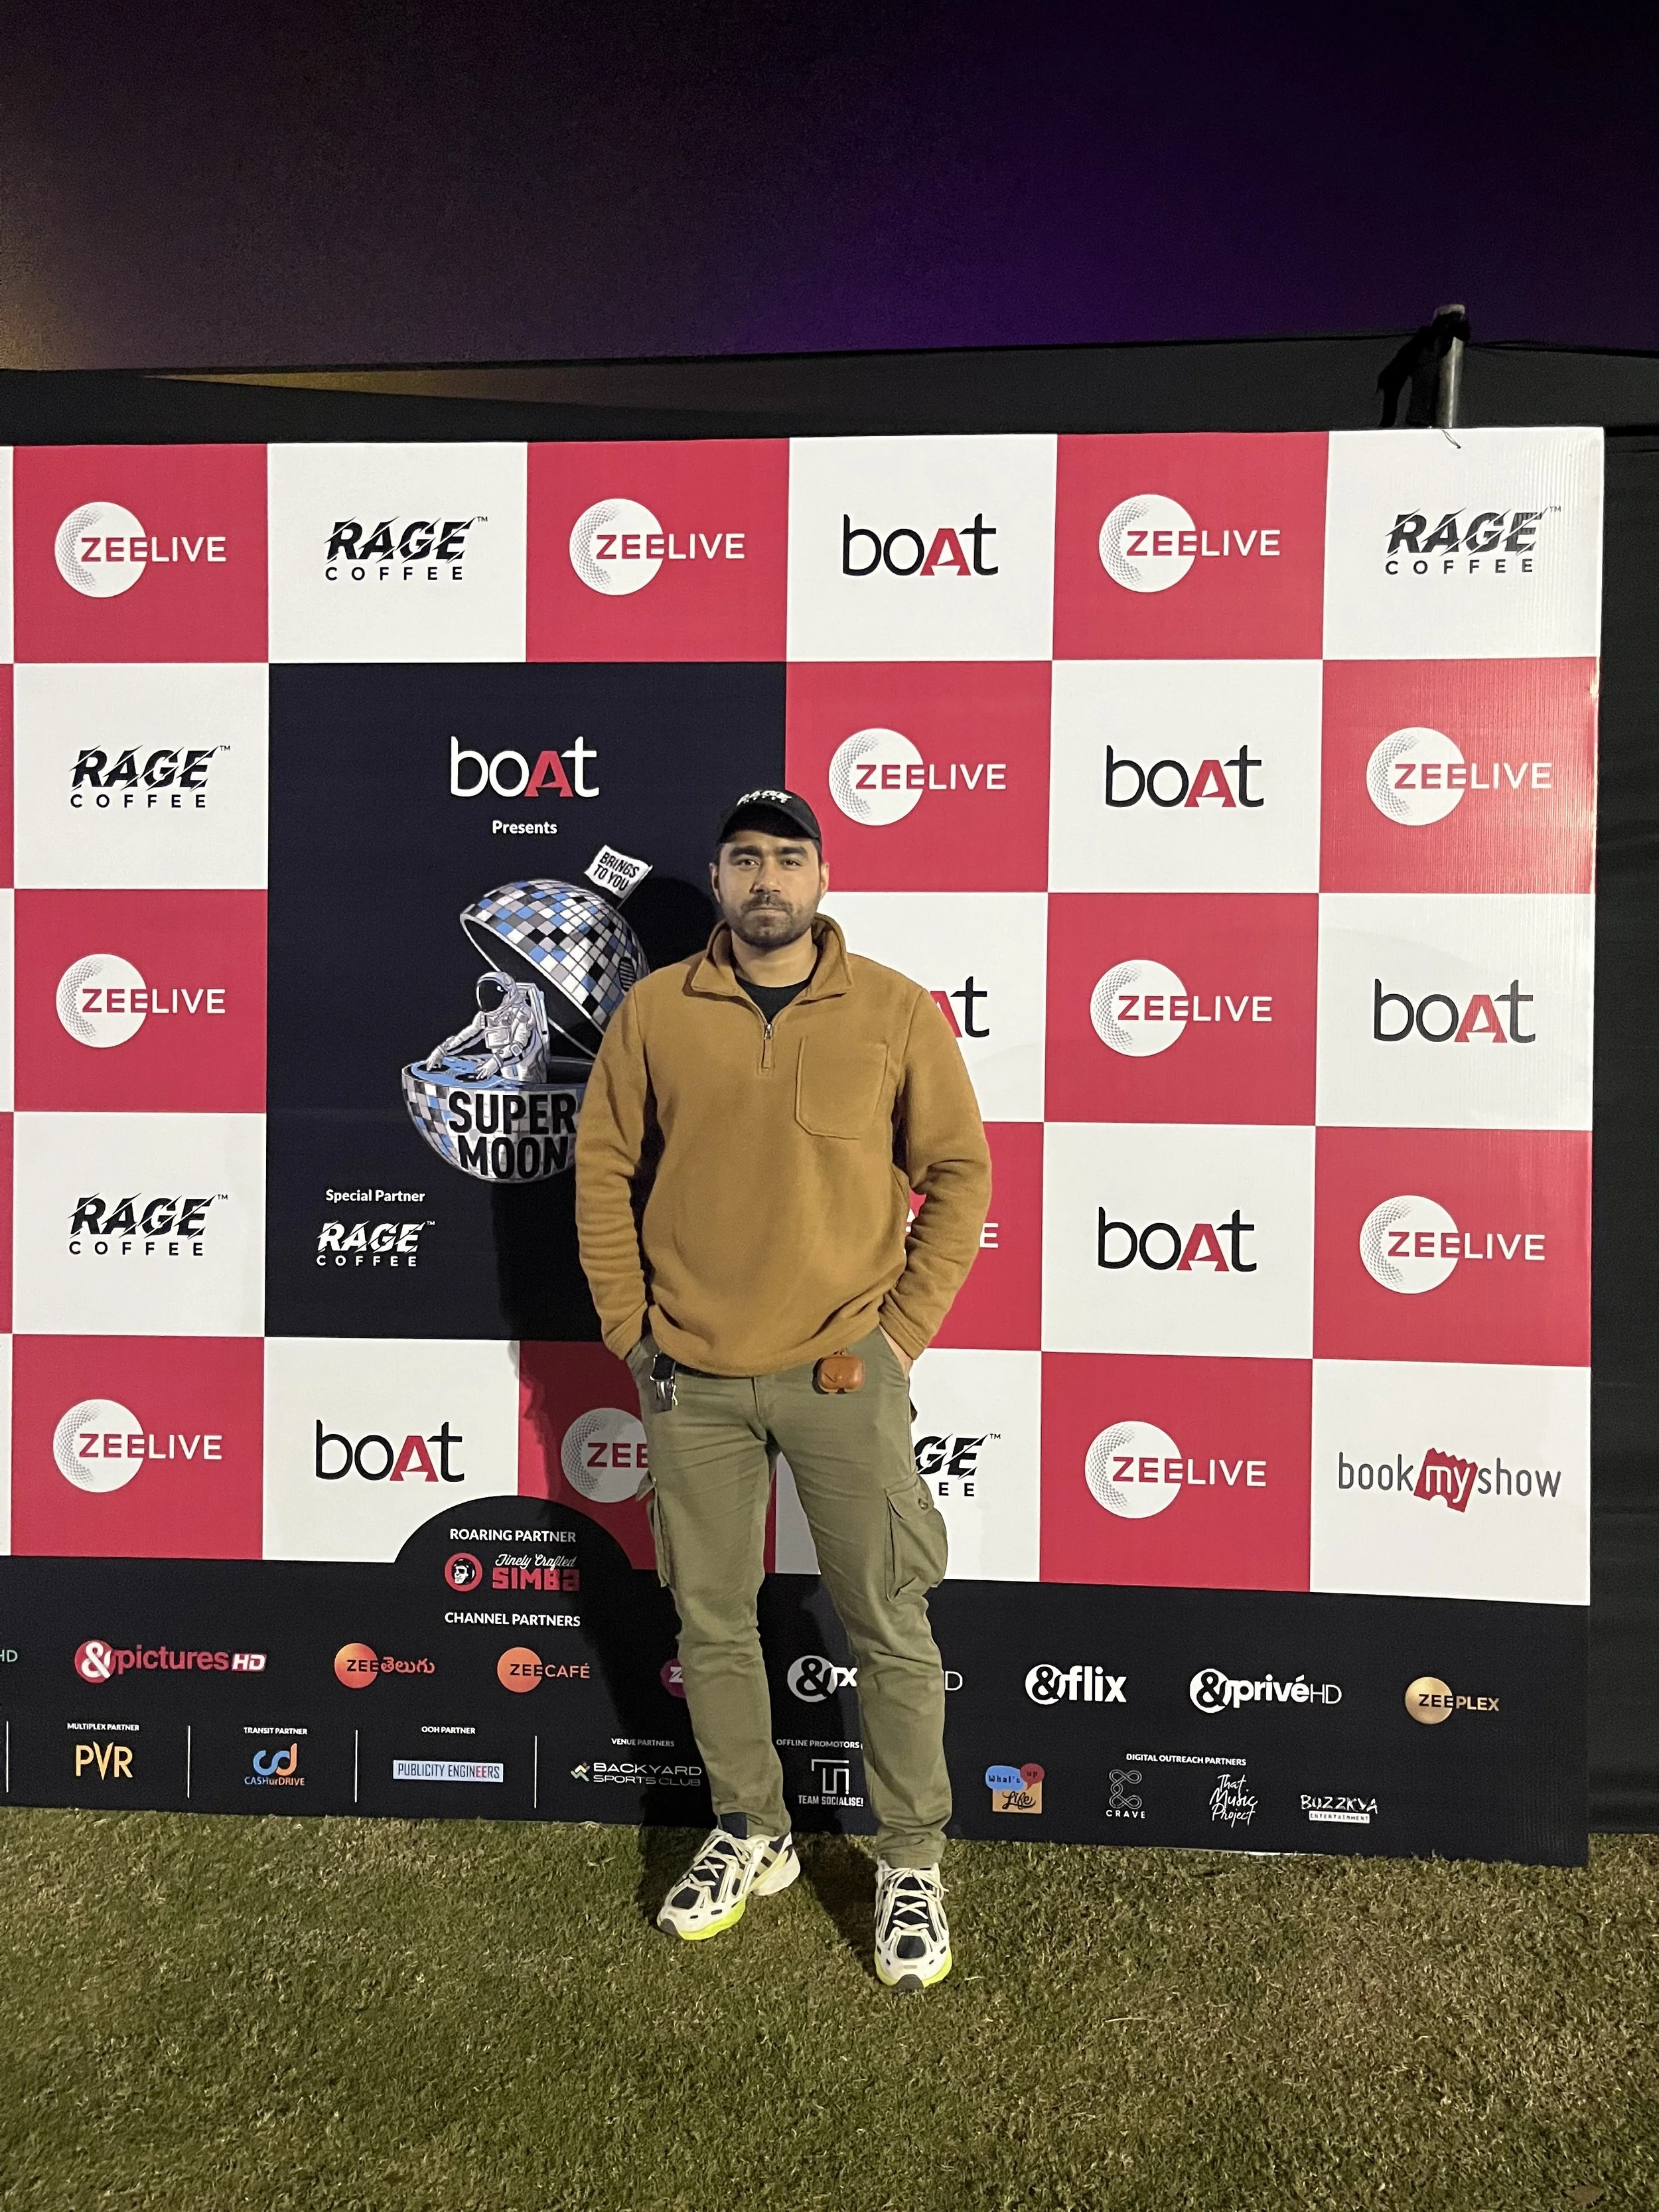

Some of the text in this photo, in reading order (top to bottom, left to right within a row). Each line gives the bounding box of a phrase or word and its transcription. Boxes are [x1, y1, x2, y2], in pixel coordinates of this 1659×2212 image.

[843, 513, 999, 576] boAt
[325, 566, 463, 581] COFFEE
[1385, 558, 1534, 575] COFFEE
[451, 735, 600, 798] boAt
[1106, 745, 1264, 808] boAt
[70, 794, 206, 808] COFFEE
[492, 820, 557, 834] Presents
[599, 851, 640, 877] BRINGS
[593, 864, 630, 891] TO YOU
[1373, 978, 1536, 1043] boAt
[449, 1091, 577, 1135] SUPER
[458, 1135, 569, 1179] MOON
[326, 1189, 425, 1204] Special Partner
[1098, 1207, 1257, 1273] boAt
[68, 1241, 204, 1256] COFFEE
[317, 1255, 417, 1267] COFFEE
[316, 1420, 465, 1482] boAt
[450, 1528, 576, 1542] ROARING PARTNER
[534, 1554, 577, 1571] Crafted
[445, 1612, 581, 1627] CHANNEL PARTNERS
[611, 1737, 636, 1746] VENUE
[76, 1741, 133, 1780] PVR
[1126, 1753, 1247, 1766] DIGITAL OUTREACH PARTNERS
[397, 1763, 500, 1779] PUBLICITY ENGINEERS
[593, 1762, 702, 1776] BACKYARD
[593, 1775, 701, 1787] SPORTS CLUB
[798, 1794, 819, 1805] TEAM
[1106, 1809, 1145, 1819] CRAVE
